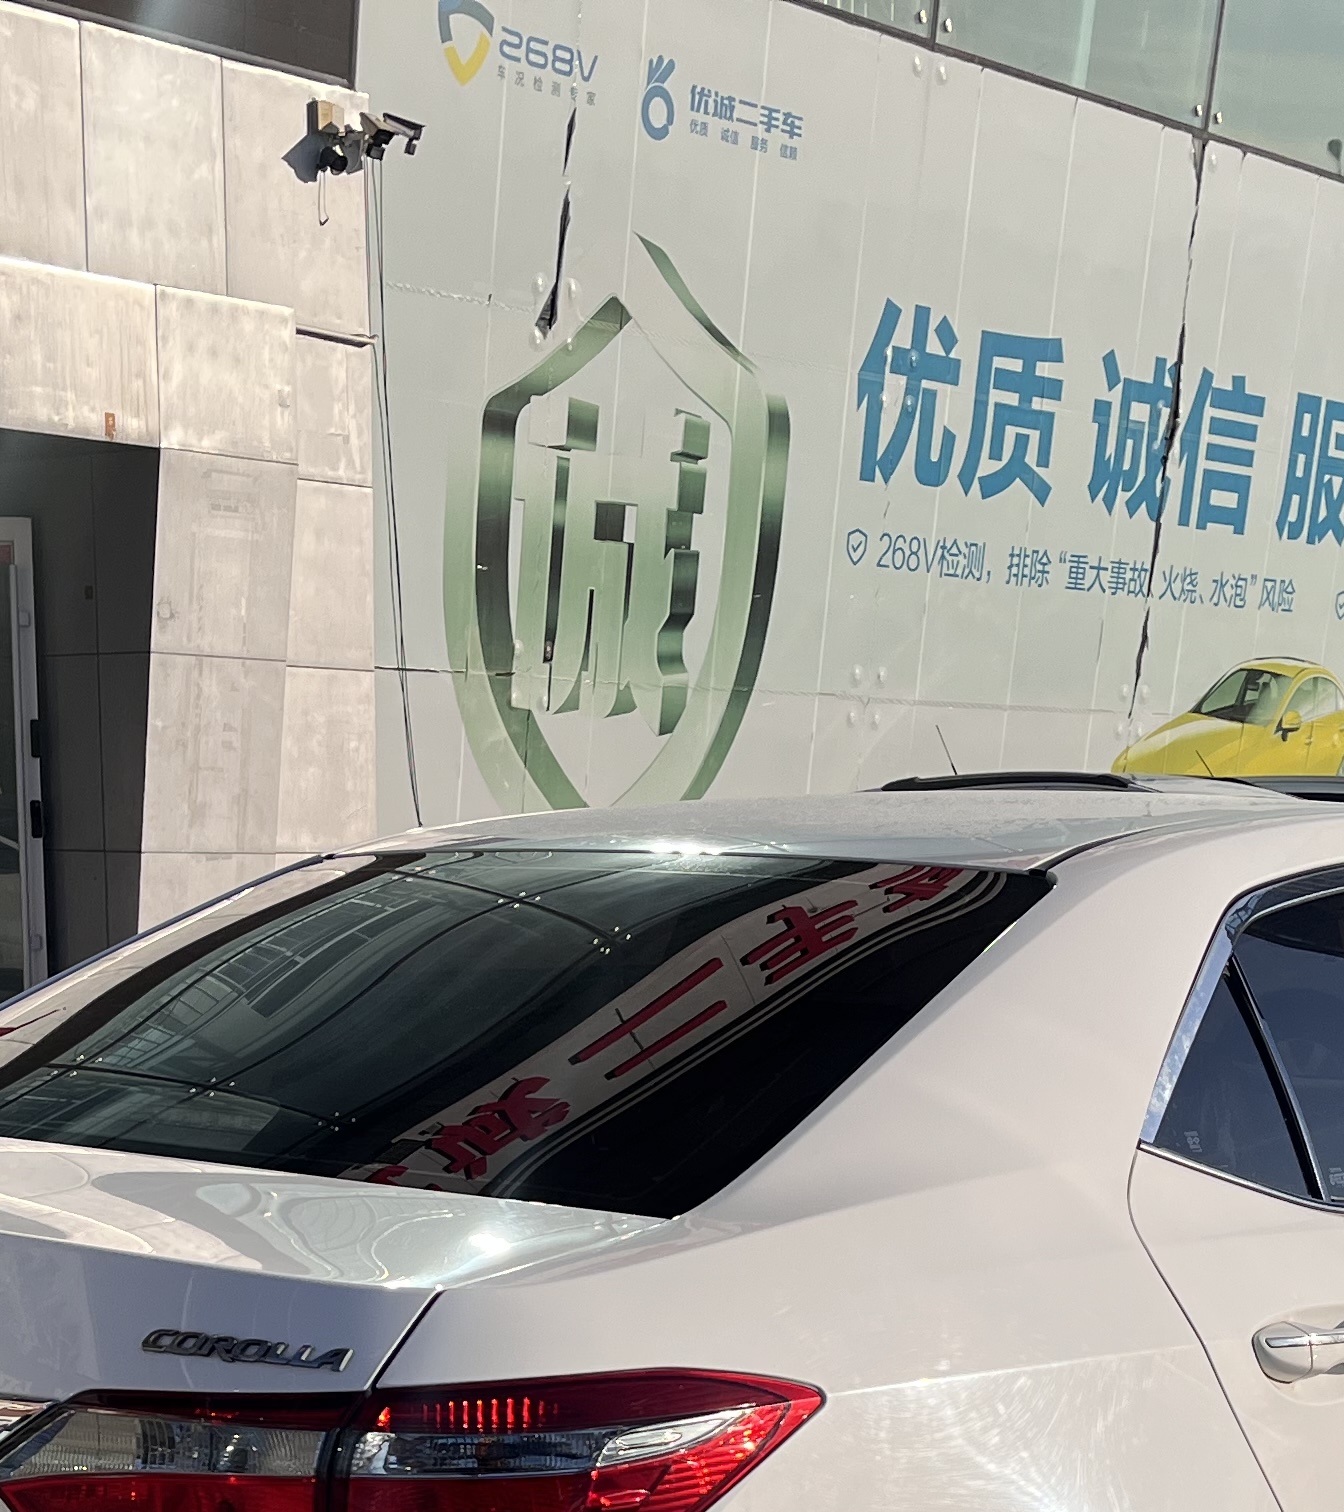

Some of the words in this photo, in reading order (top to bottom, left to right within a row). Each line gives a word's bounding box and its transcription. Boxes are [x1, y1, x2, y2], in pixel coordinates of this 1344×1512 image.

[499, 26, 599, 83] 268V
[690, 84, 804, 140] 优诚二手车
[857, 297, 1065, 508] 优质
[1086, 348, 1267, 536] 诚信
[141, 1328, 355, 1373] COROLLA
